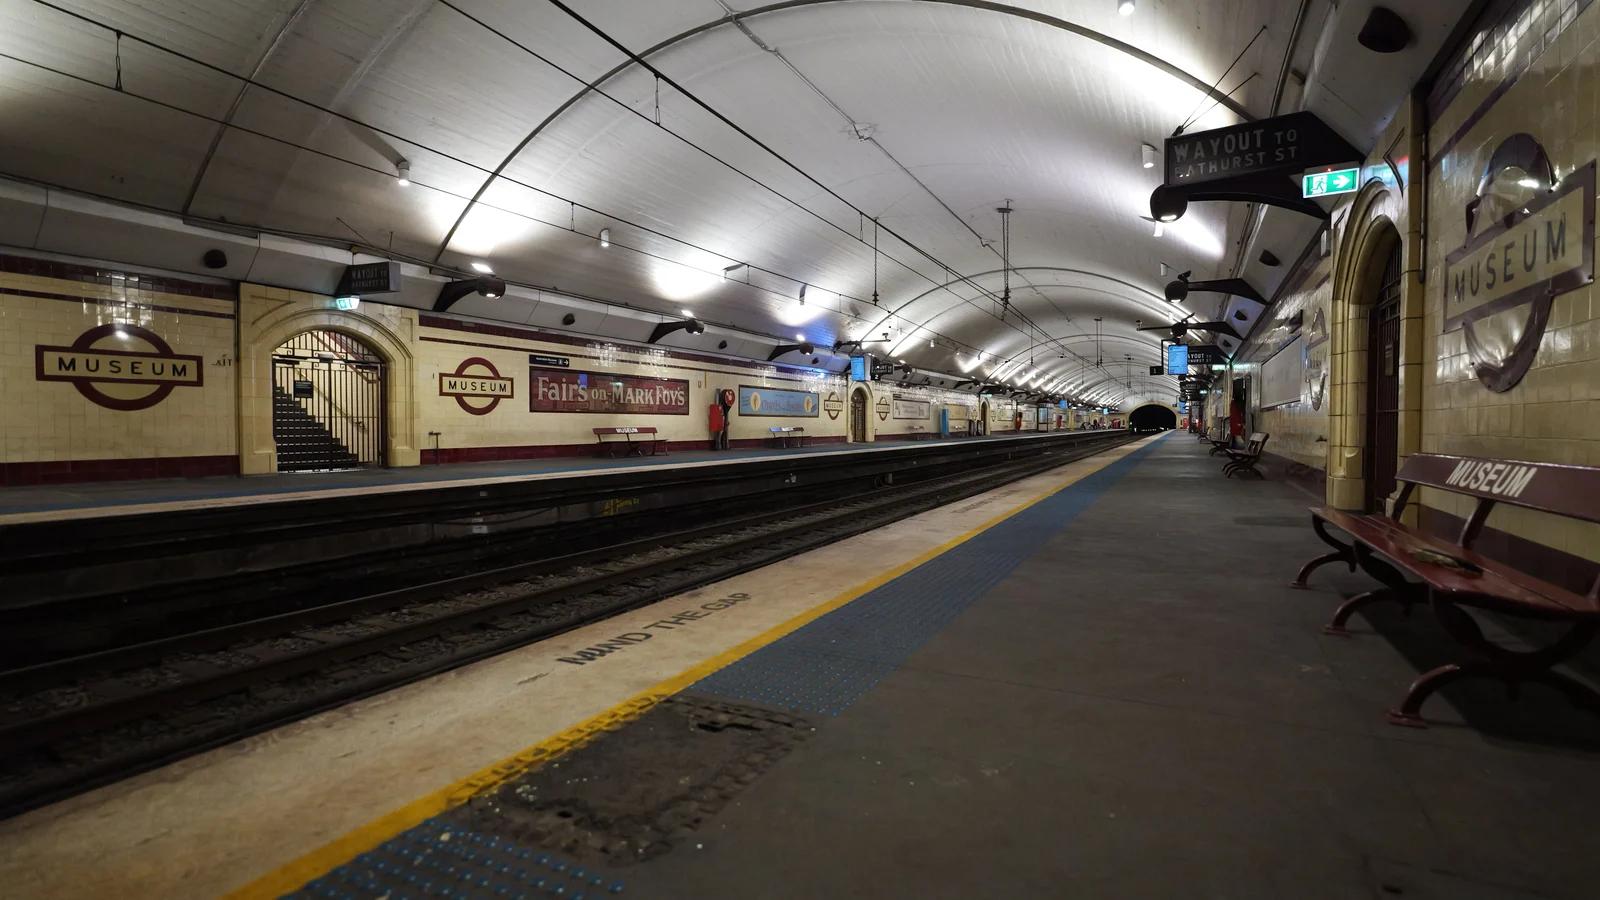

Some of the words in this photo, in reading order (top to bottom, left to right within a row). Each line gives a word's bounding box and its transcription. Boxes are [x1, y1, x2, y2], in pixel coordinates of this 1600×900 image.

[1173, 129, 1265, 163] WAYOUT
[1275, 129, 1298, 145] TO
[1175, 152, 1266, 179] BATHURST
[1276, 147, 1298, 162] ST
[1454, 211, 1567, 304] MUSEUM
[57, 356, 188, 378] MUSEUM
[448, 380, 508, 393] MUSEUM
[612, 384, 654, 405] MARK
[1446, 460, 1537, 498] MUSEUM
[643, 609, 711, 630] THE
[706, 592, 752, 611] GAP
